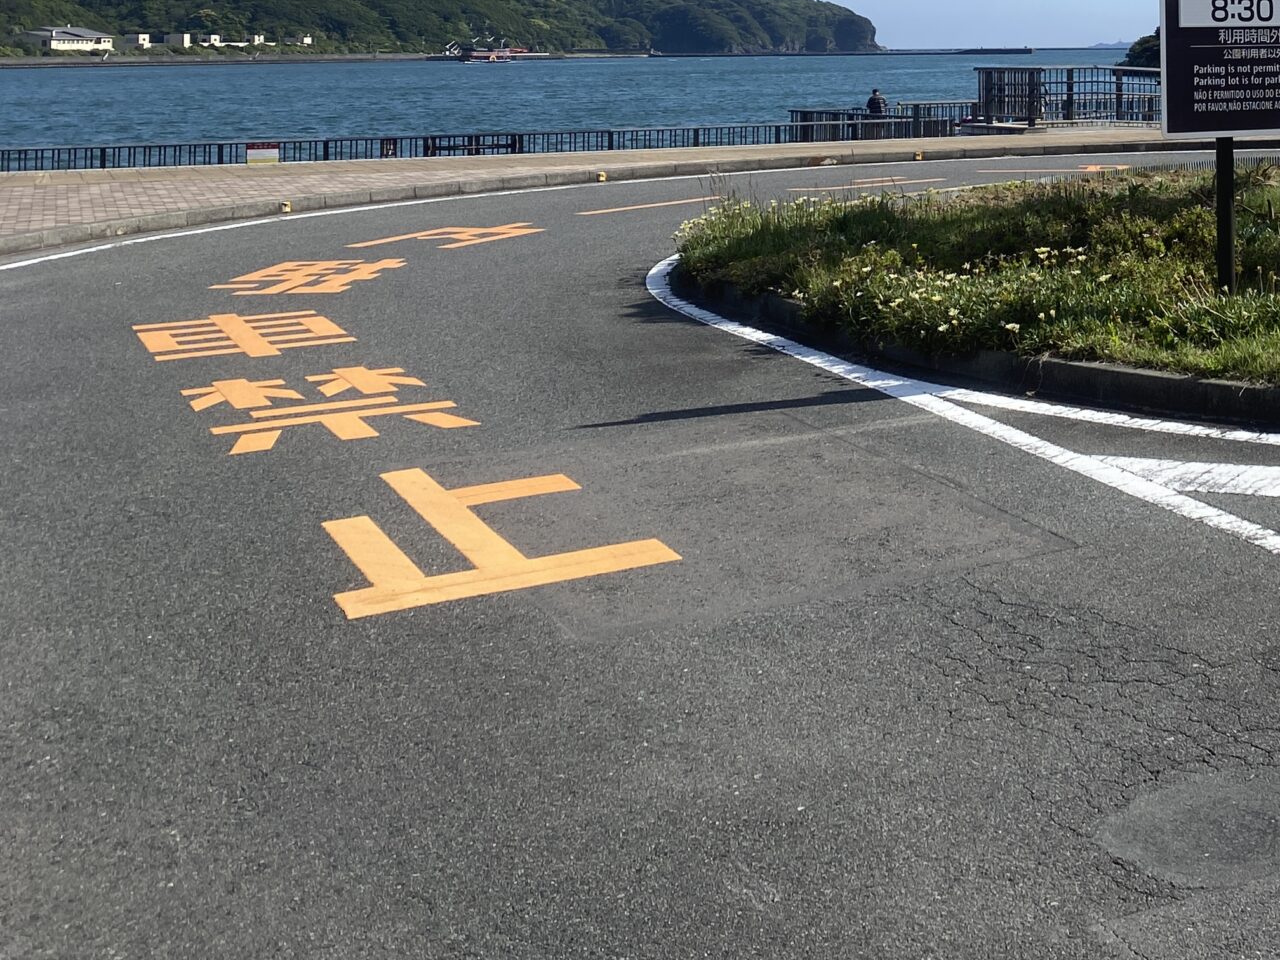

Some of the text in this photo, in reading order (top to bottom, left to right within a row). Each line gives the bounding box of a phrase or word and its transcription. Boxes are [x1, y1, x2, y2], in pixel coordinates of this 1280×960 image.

[1193, 64, 1225, 75] Parking
[1227, 63, 1235, 73] is
[1237, 64, 1250, 72] not
[1193, 75, 1225, 87] Parking
[1228, 75, 1239, 84] lot
[1241, 75, 1248, 84] is
[1250, 75, 1263, 84] for
[1193, 88, 1207, 99] NÃO
[1208, 89, 1212, 99] É
[1213, 89, 1244, 99] PERMITIDO
[1245, 89, 1251, 98] O
[1251, 89, 1264, 98] USO
[1265, 88, 1274, 97] DO
[1193, 102, 1206, 111] POR
[1242, 100, 1273, 110] ESTACIONE
